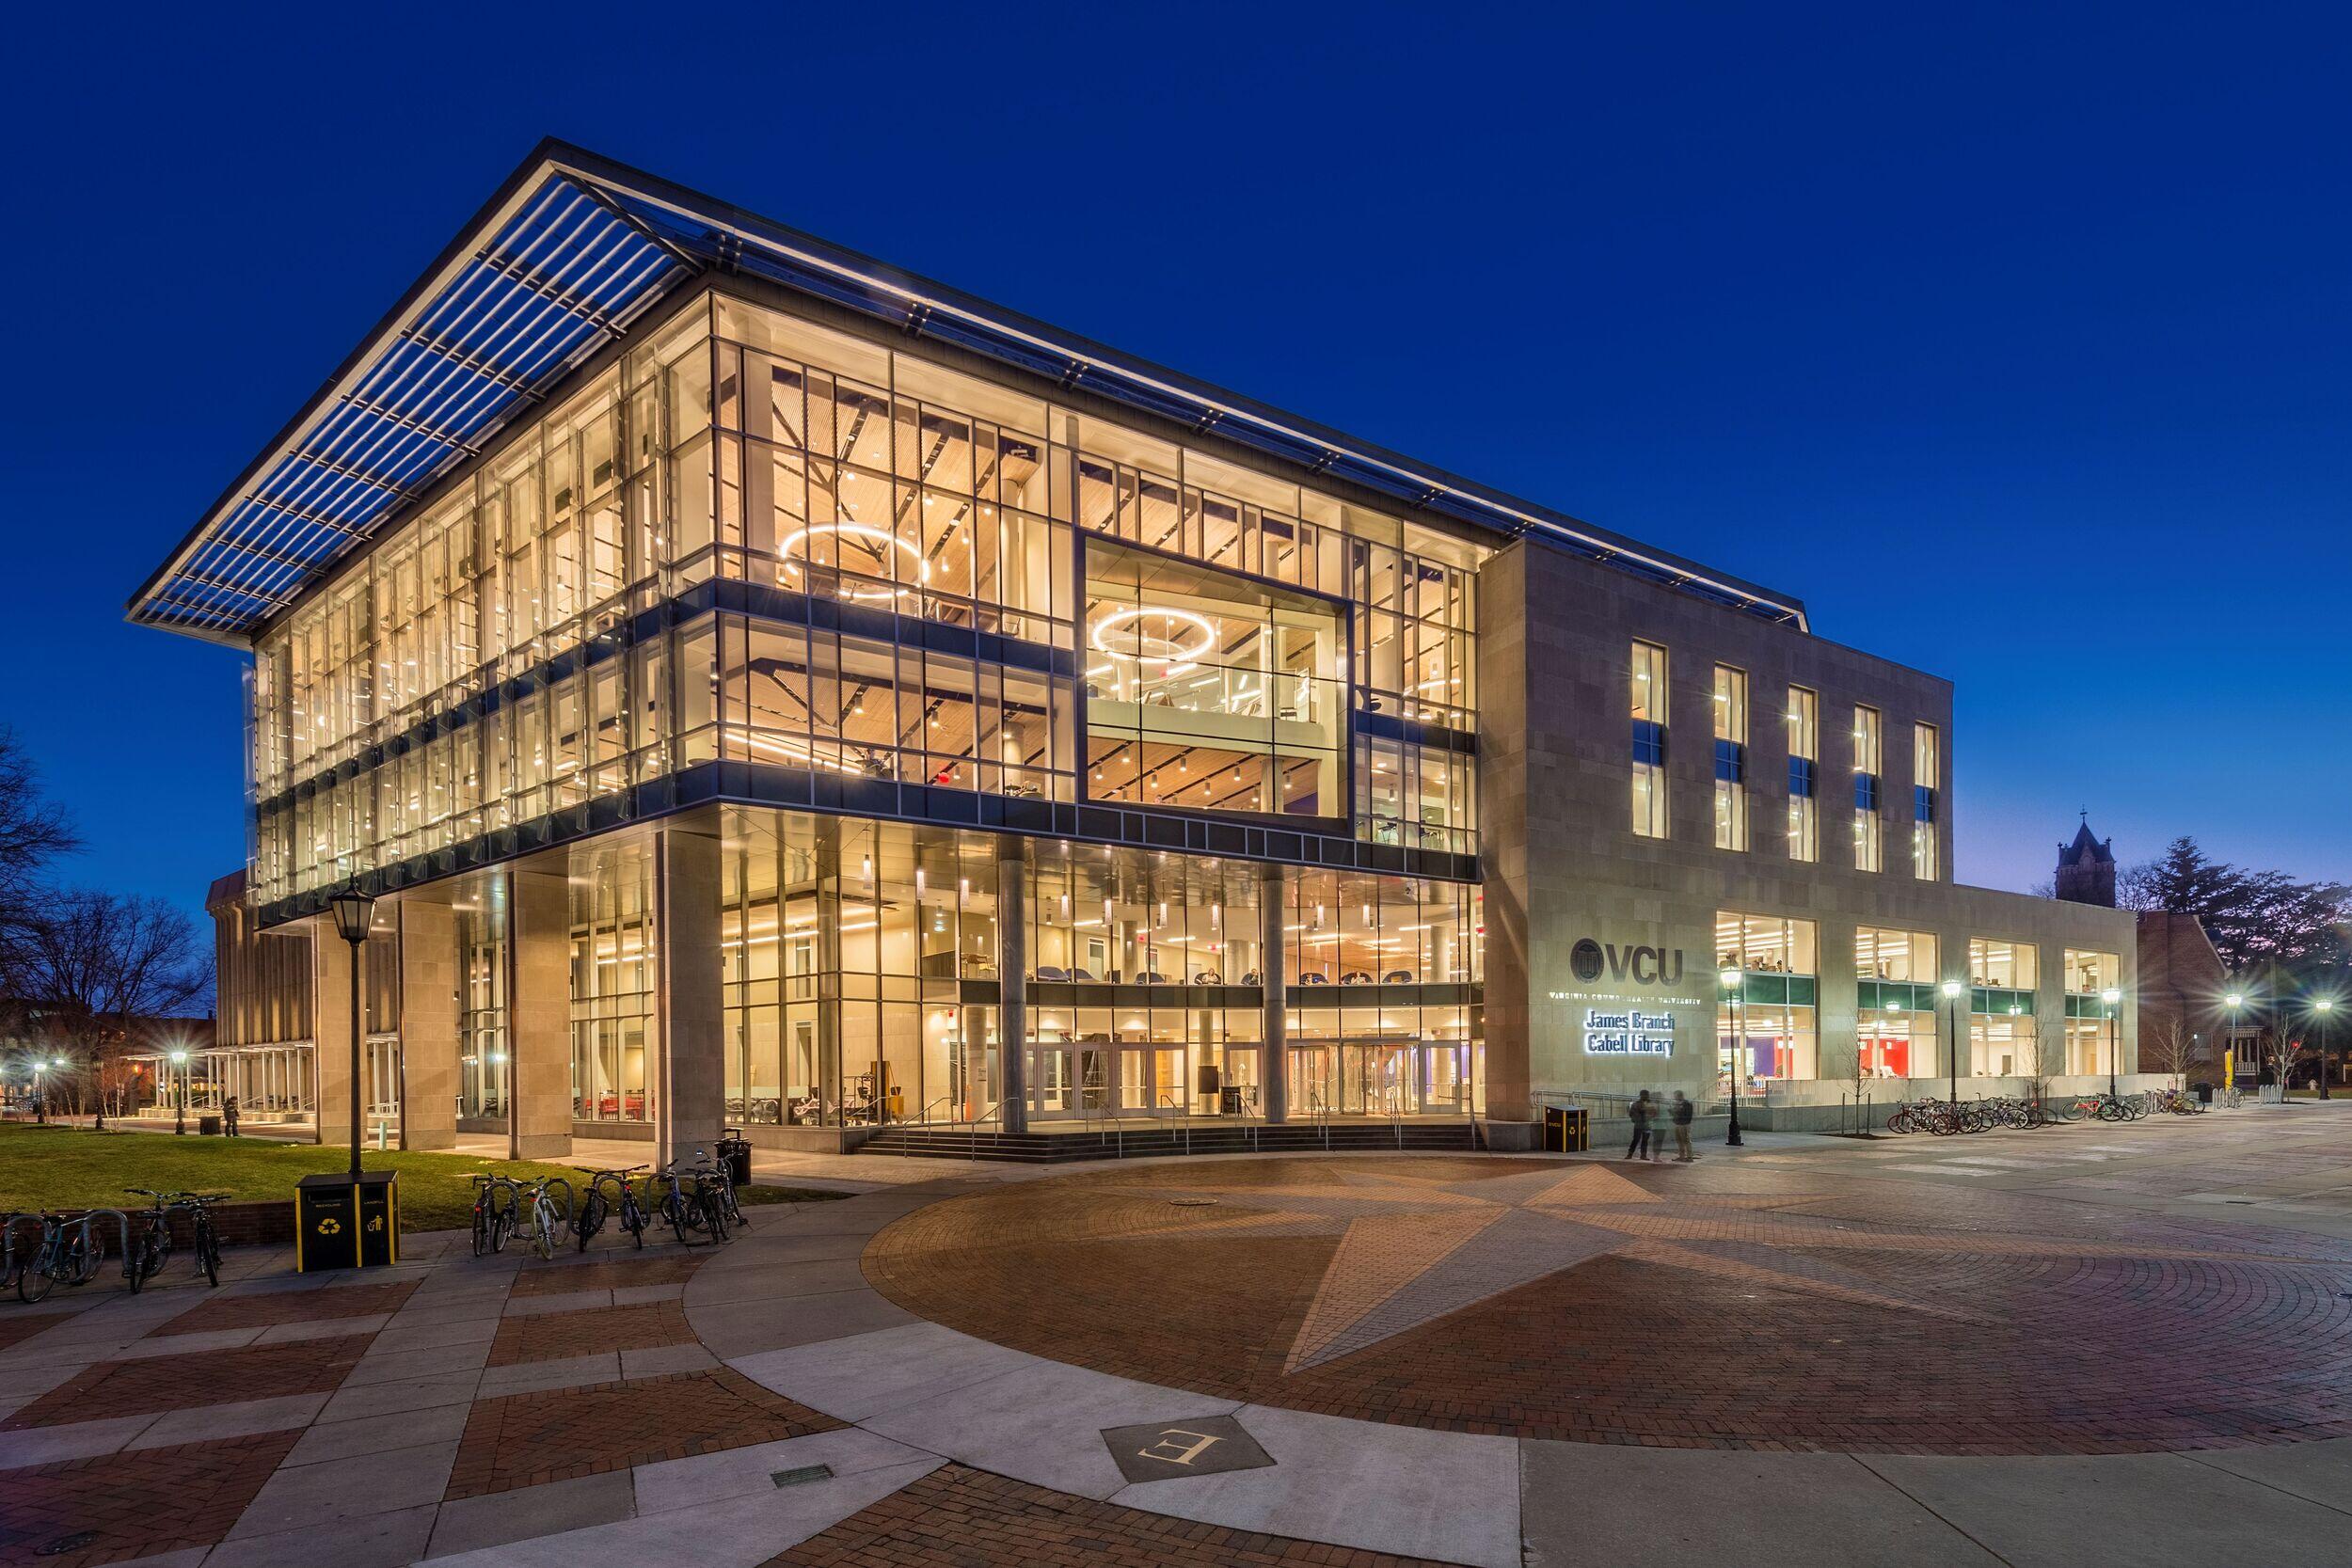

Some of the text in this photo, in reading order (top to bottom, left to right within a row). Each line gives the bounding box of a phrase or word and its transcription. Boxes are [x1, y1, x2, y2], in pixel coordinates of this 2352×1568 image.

[1605, 943, 1683, 986] VCU
[1591, 993, 1655, 1003] COMMOWEATH
[1586, 1010, 1675, 1030] James Branch
[1587, 1035, 1675, 1056] Cabell Library
[1137, 1429, 1228, 1465] E
